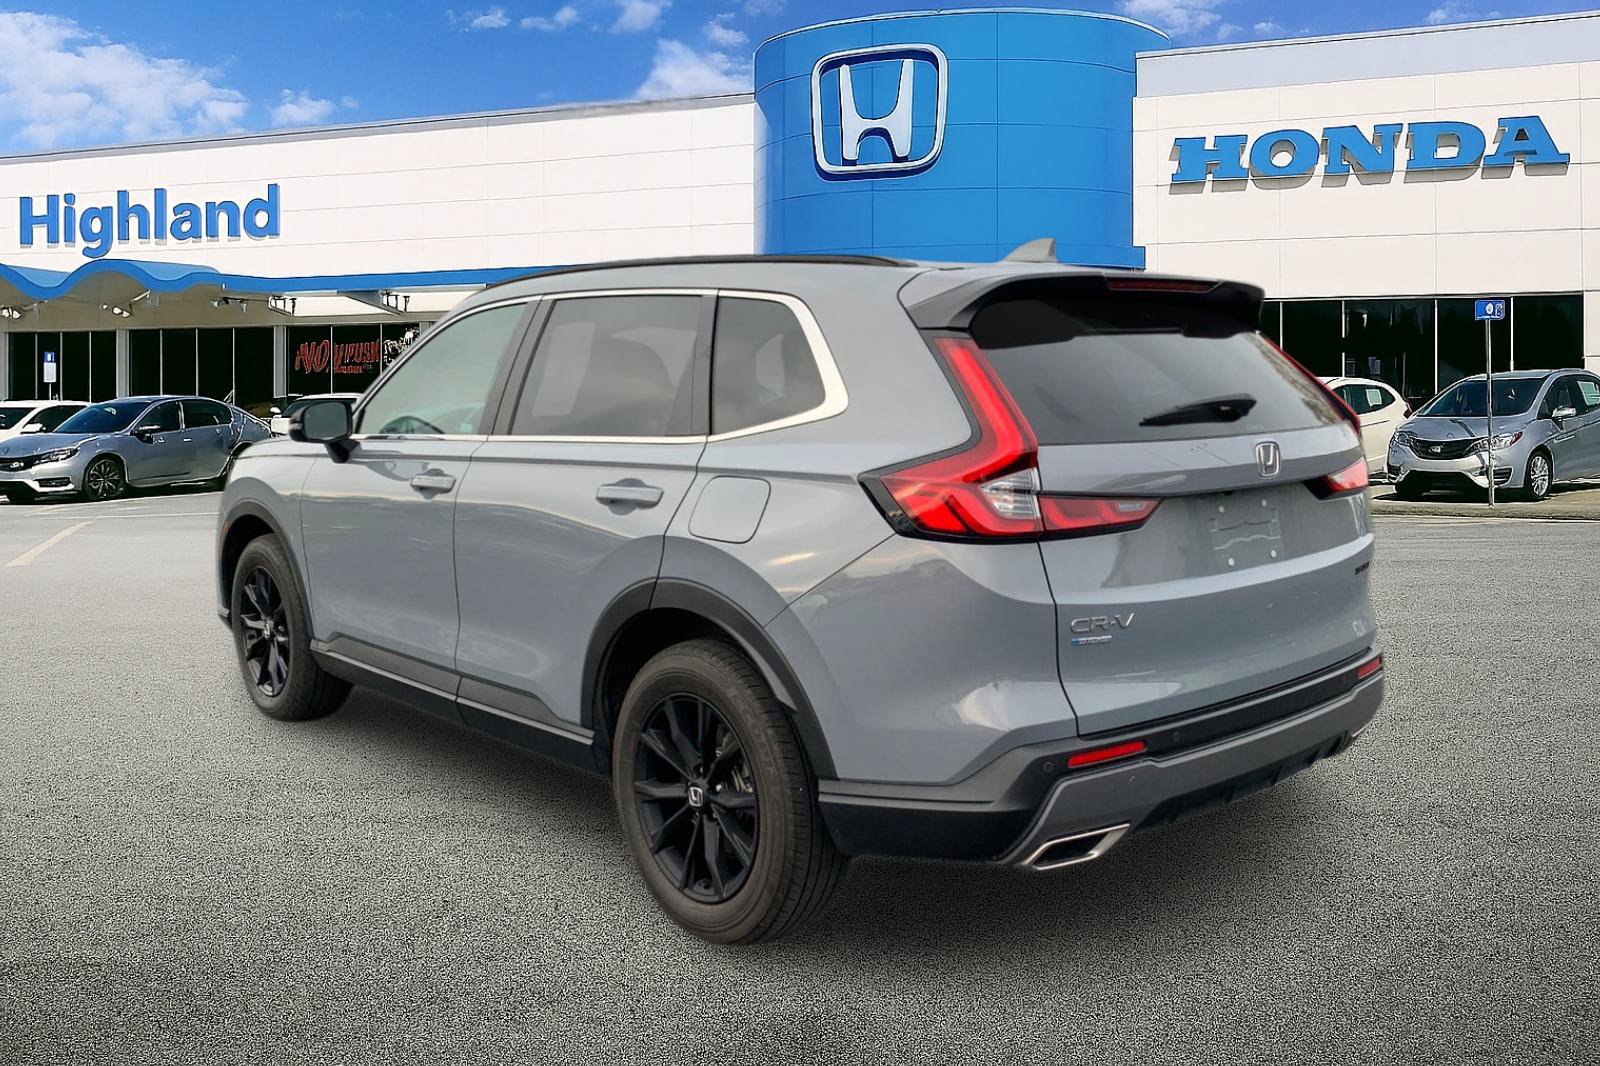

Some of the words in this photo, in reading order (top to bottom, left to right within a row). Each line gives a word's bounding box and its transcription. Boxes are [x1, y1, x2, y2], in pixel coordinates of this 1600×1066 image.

[1168, 115, 1571, 187] HONDA
[19, 183, 281, 258] Highland
[1070, 612, 1135, 633] CR-V
